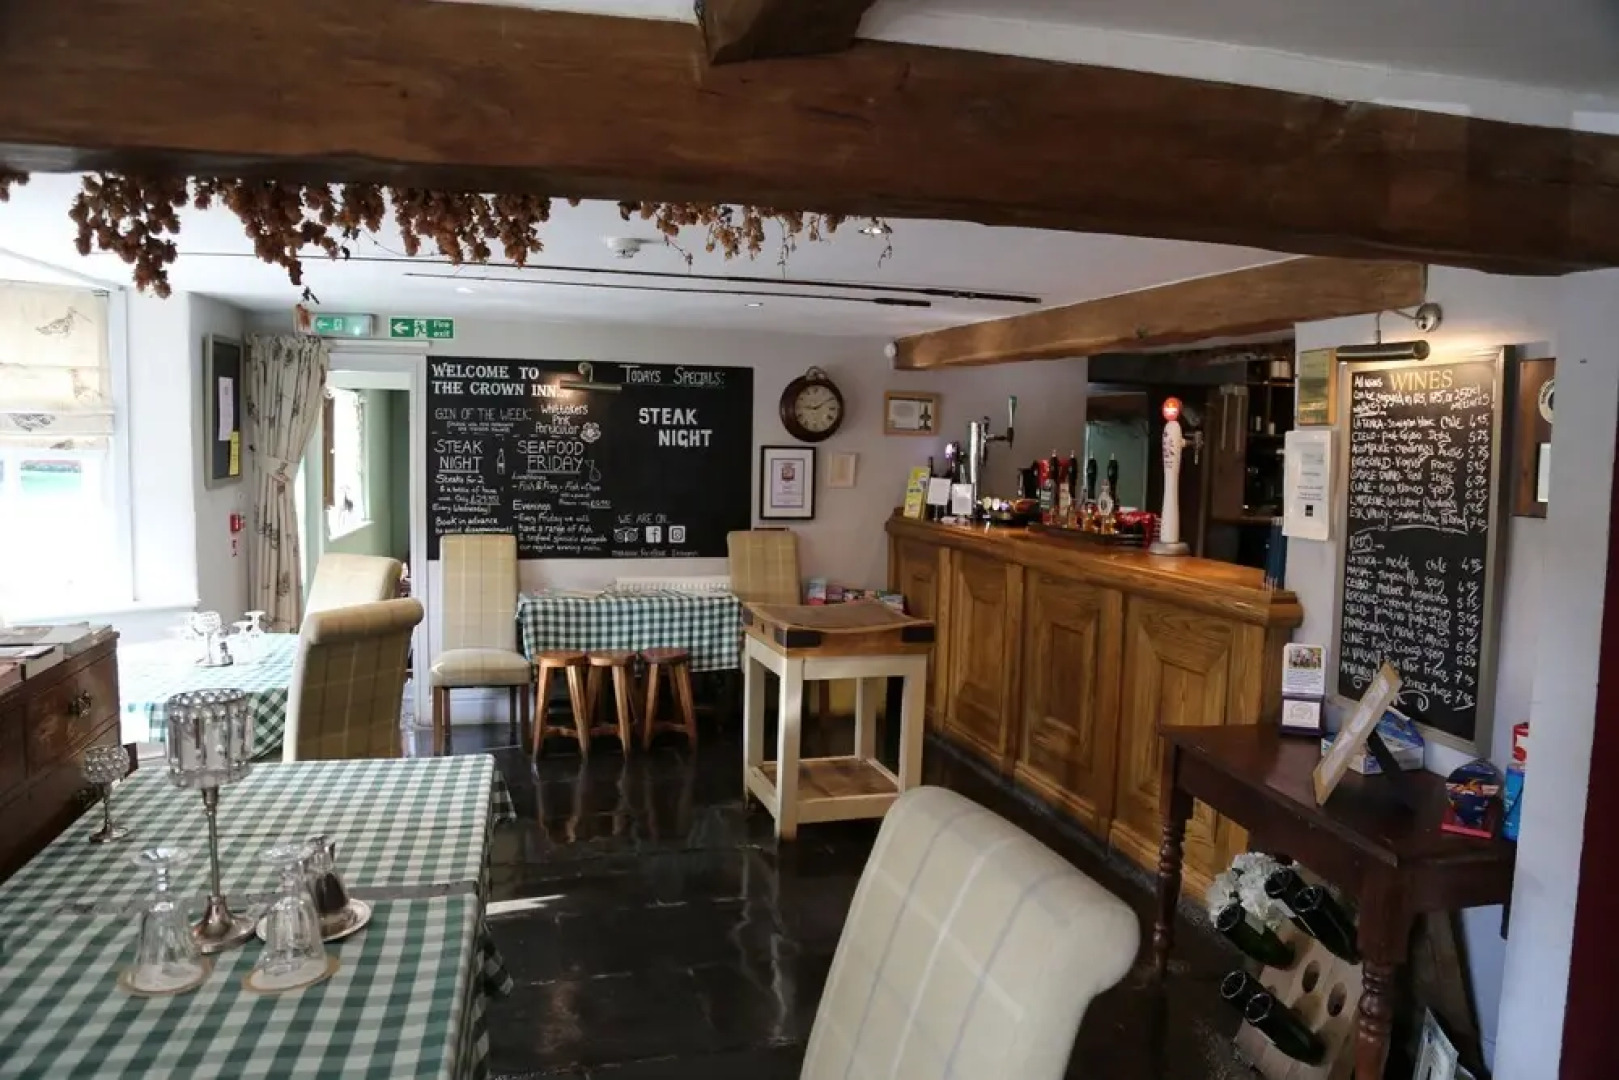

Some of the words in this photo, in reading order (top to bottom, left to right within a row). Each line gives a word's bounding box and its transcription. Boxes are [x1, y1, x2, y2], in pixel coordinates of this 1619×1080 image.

[431, 363, 510, 379] WELCOME
[518, 366, 540, 380] TO
[1389, 369, 1454, 391] WINES
[431, 381, 464, 395] THE
[469, 382, 525, 396] CROWN
[434, 407, 457, 420] GIN
[461, 408, 472, 420] OF
[477, 407, 496, 421] THE
[638, 408, 699, 425] STEAK
[434, 438, 484, 454] STEAK
[658, 429, 713, 448] NIGHT
[517, 441, 584, 456] SEAFOOD
[439, 455, 484, 471] NIGHT
[527, 454, 584, 471] FRIDAY
